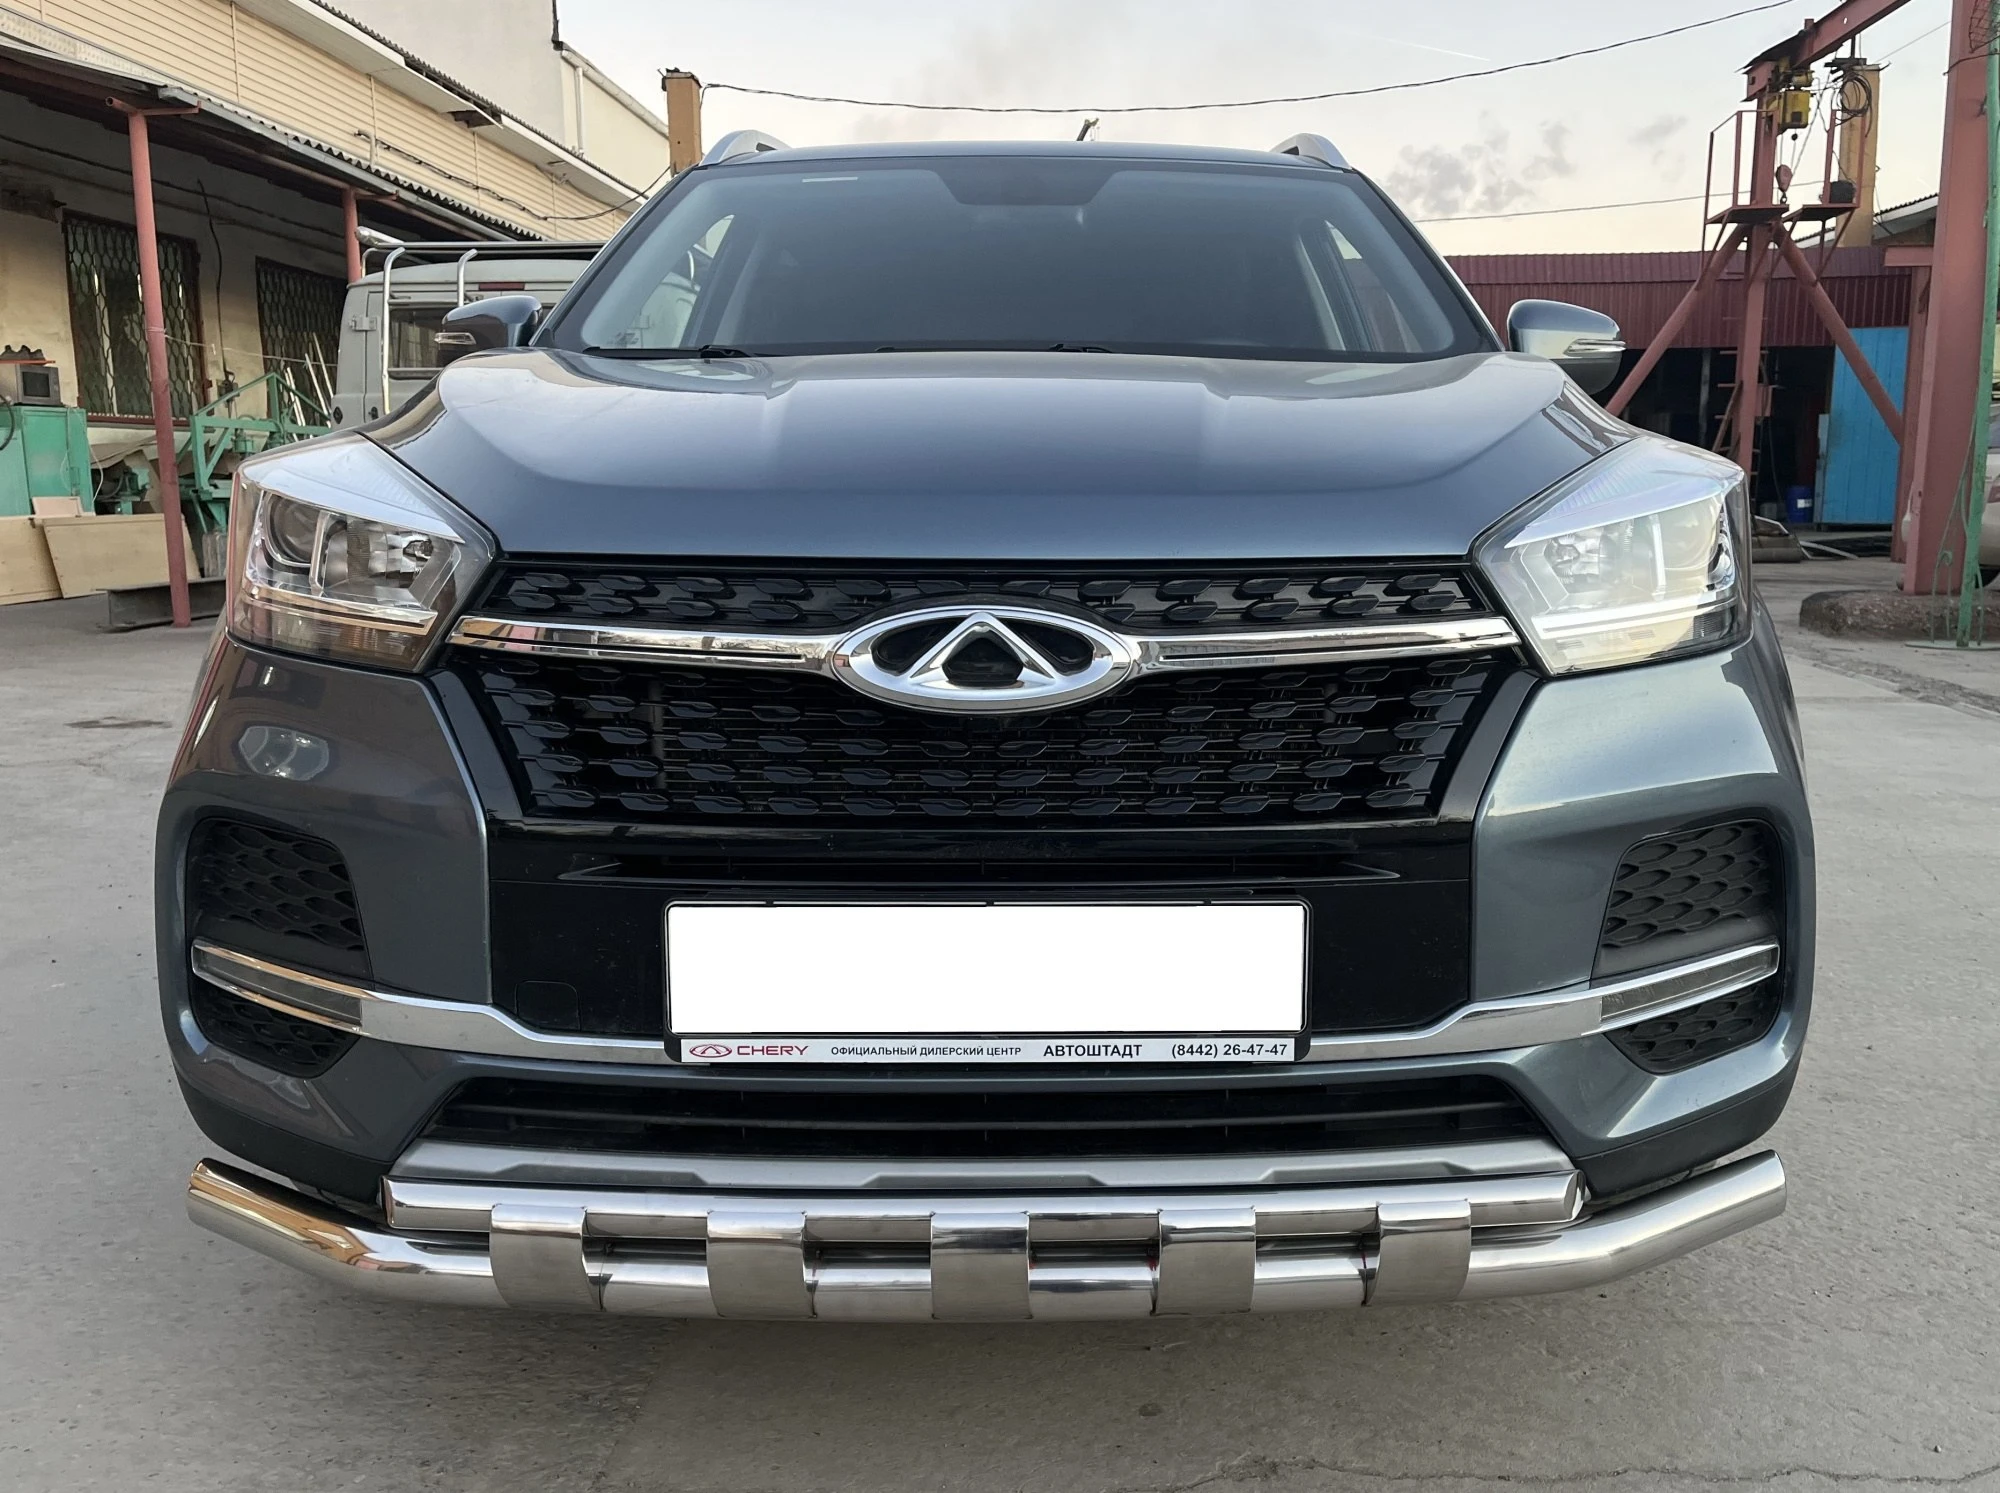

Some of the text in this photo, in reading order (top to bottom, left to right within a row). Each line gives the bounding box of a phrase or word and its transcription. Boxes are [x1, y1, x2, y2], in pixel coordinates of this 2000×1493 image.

[737, 1045, 809, 1056] CHERY
[831, 1044, 1288, 1058] ОФИЦИАЛЬНЫЙ ДИЛЕРСКИЙ ЦЕНТР АВТОШТАДТ (8442) 26-47-47
